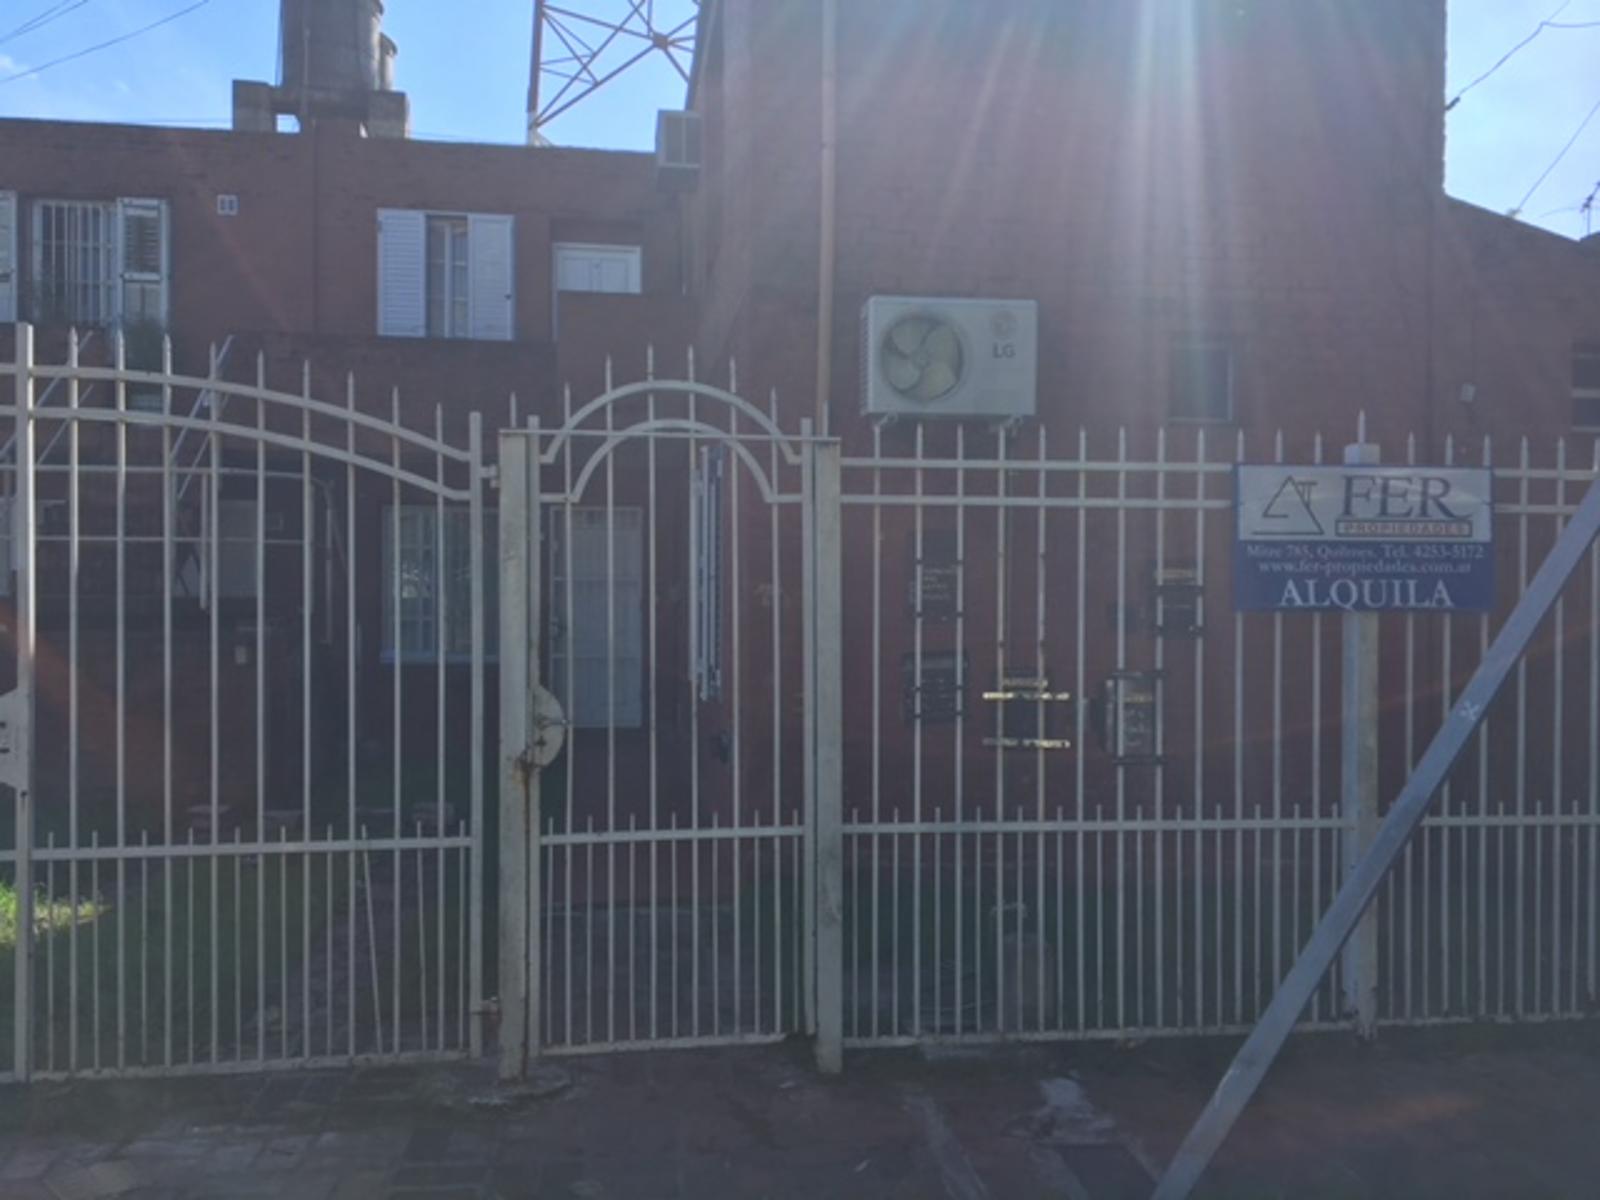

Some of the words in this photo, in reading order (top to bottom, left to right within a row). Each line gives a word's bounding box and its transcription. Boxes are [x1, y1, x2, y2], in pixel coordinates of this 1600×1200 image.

[992, 342, 1016, 359] LG
[1341, 475, 1473, 519] FER
[1279, 578, 1454, 609] ALQUILA
